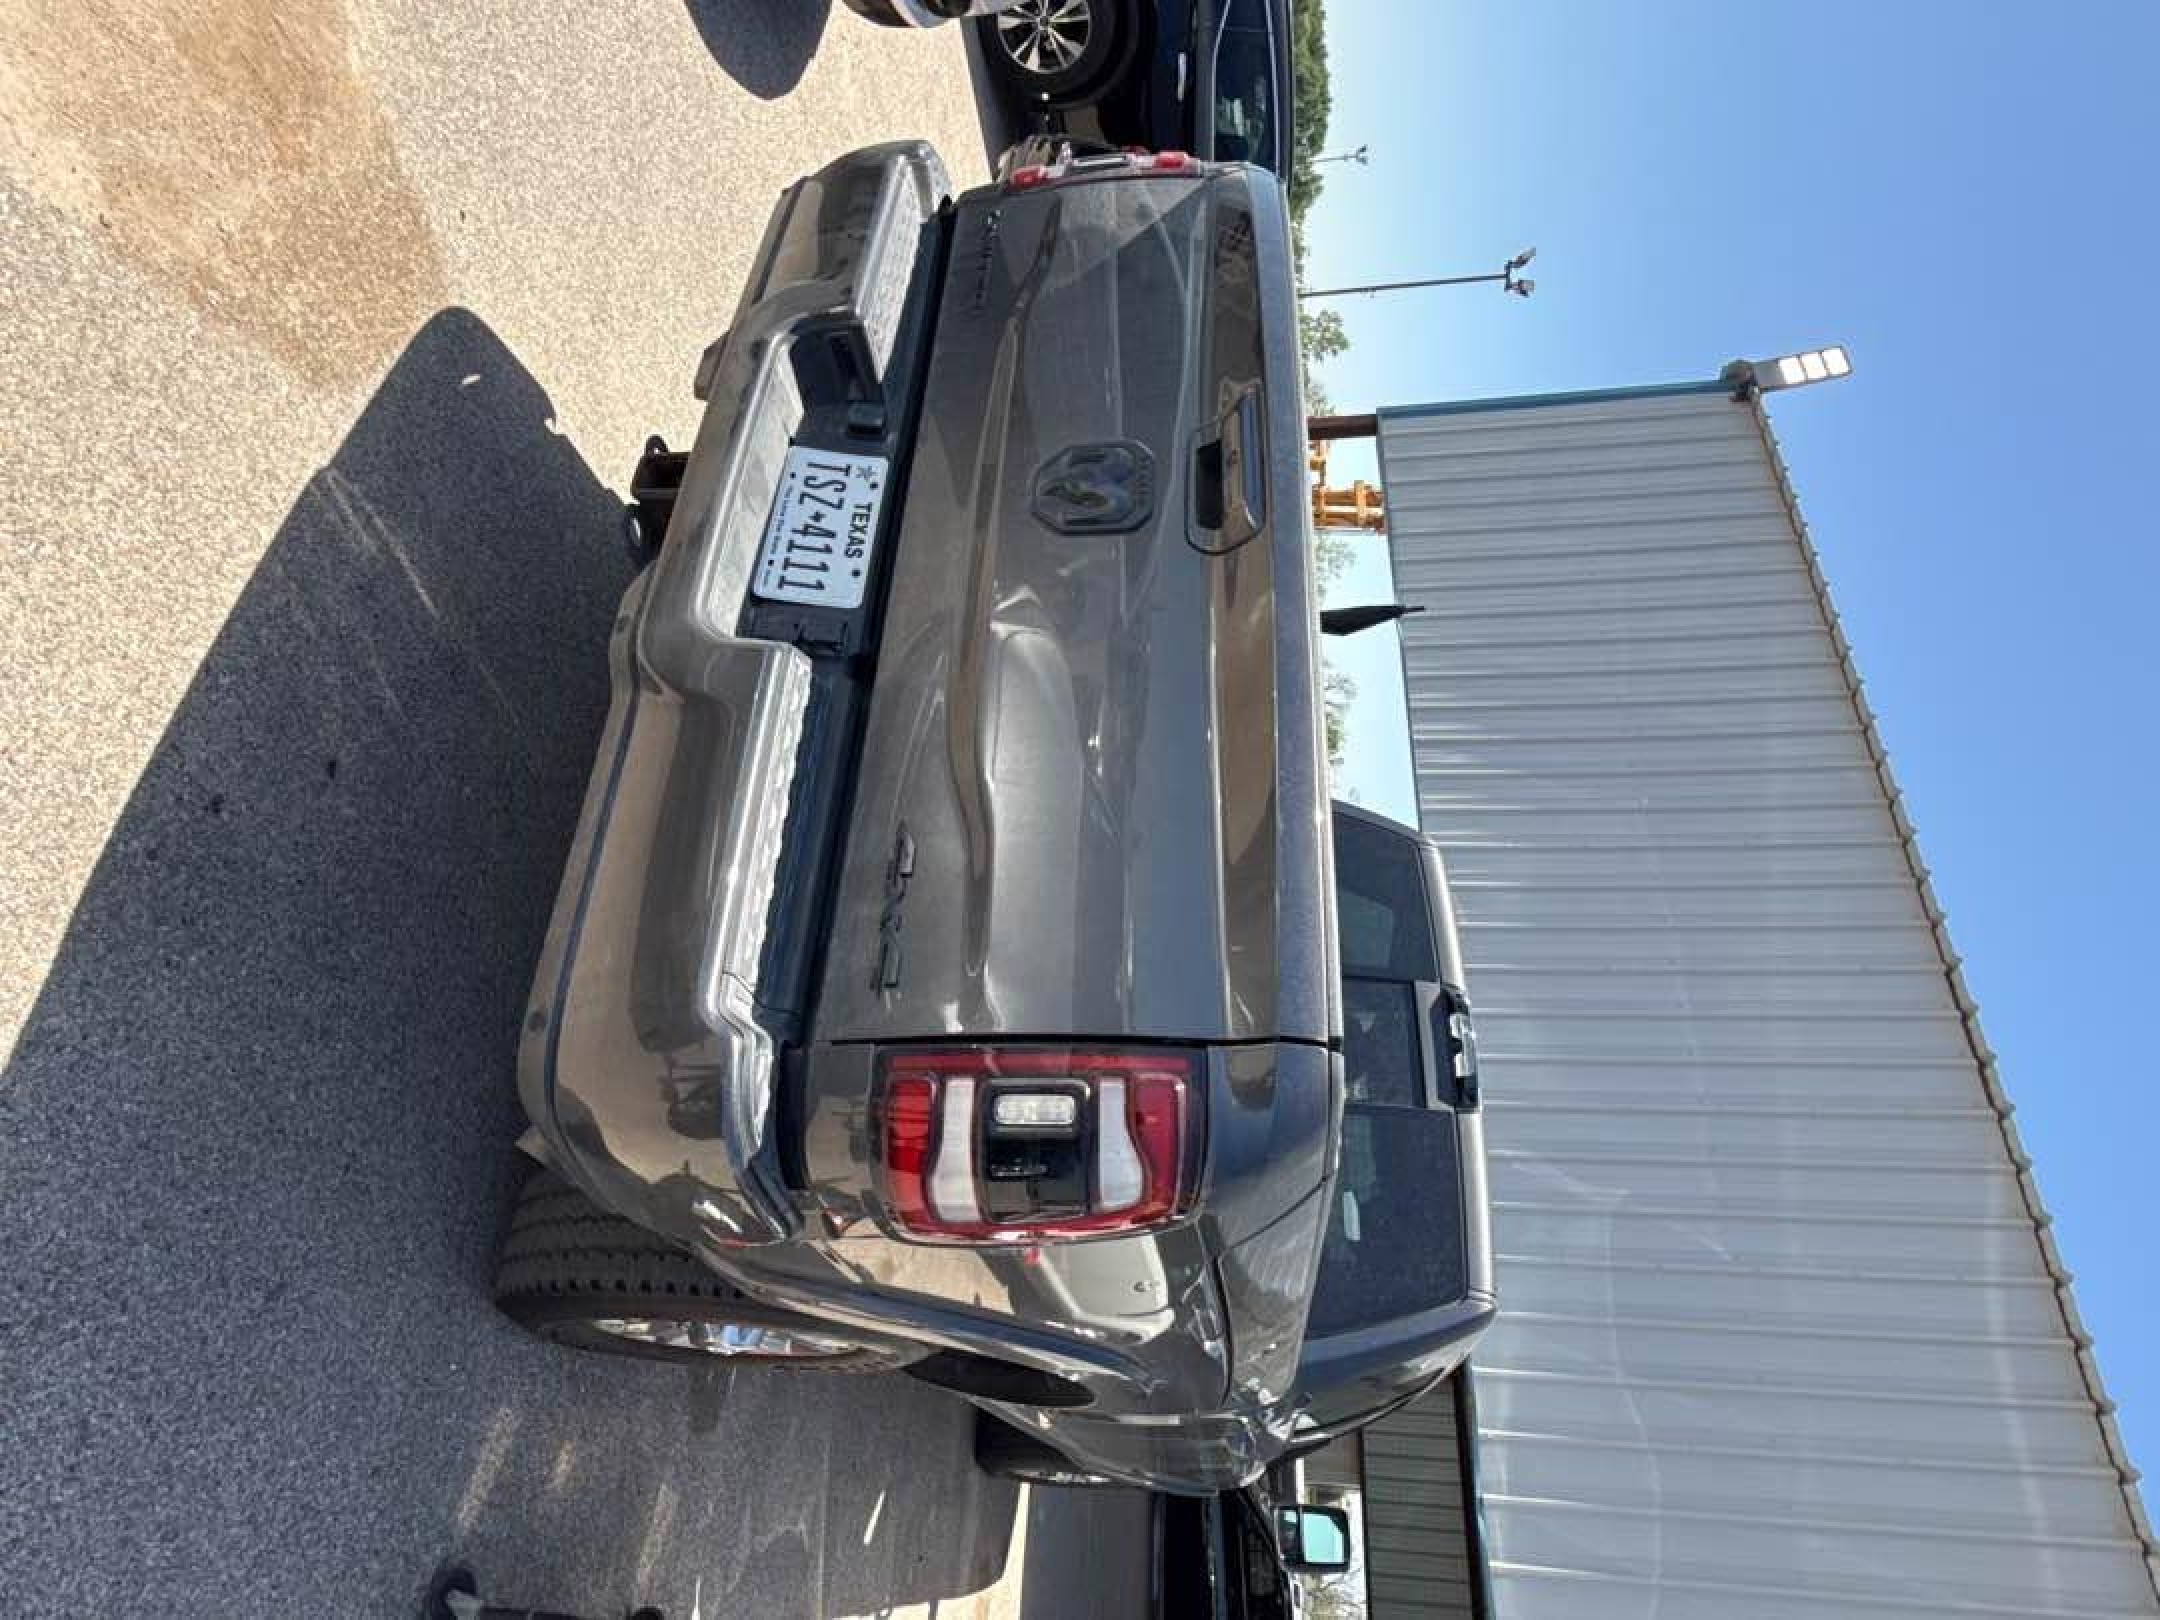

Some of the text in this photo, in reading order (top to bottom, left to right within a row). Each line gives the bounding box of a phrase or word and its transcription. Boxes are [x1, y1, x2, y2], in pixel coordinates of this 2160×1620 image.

[798, 462, 851, 510] TSZ
[777, 523, 837, 591] 4111
[845, 502, 873, 559] TEXAS
